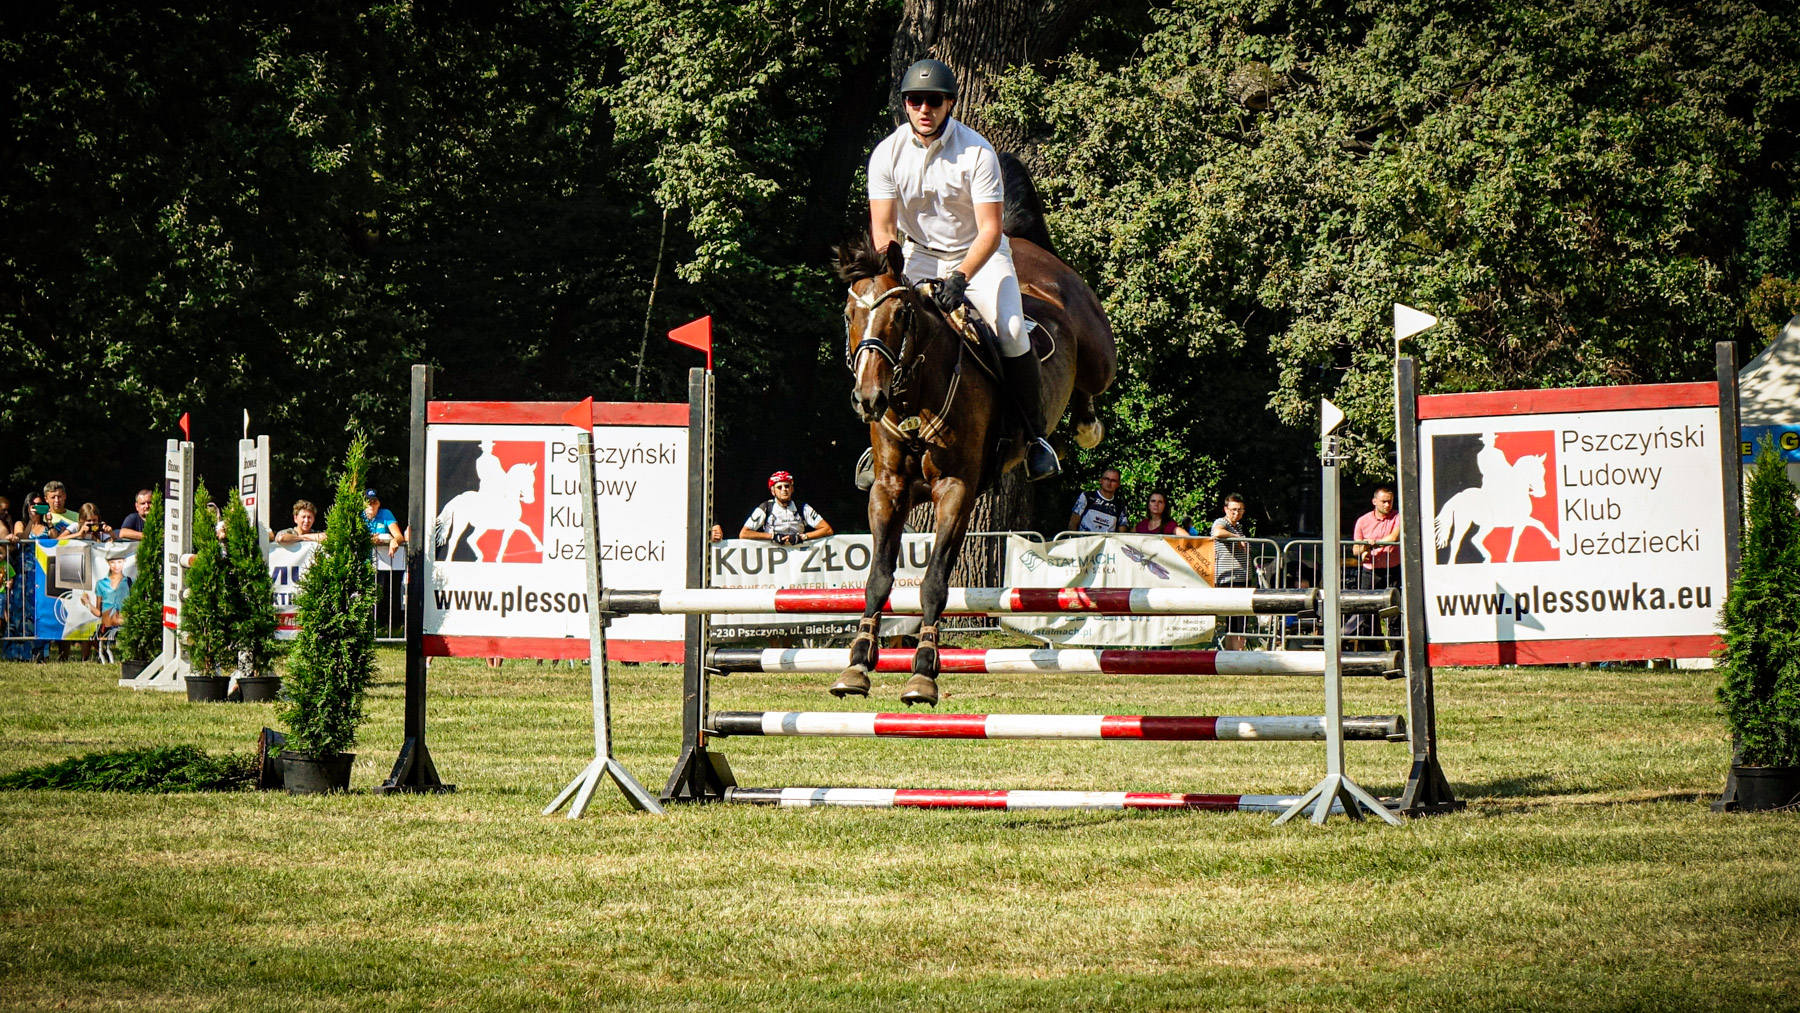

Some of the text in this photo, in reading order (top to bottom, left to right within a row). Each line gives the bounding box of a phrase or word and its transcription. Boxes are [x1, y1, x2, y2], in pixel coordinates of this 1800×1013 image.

[1562, 424, 1704, 456] Pszczyński
[551, 442, 676, 470] Psczyński
[1563, 463, 1663, 490] Ludowy
[550, 506, 584, 528] Klu
[1565, 497, 1622, 521] Klub
[548, 538, 665, 561] Jeźziecki
[1566, 528, 1699, 556] Jeździecki
[434, 585, 589, 618] www.plesso
[1436, 582, 1712, 621] www.plessowka.eu
[738, 626, 788, 637] Pszczyna,
[790, 625, 803, 635] ul.
[805, 624, 843, 635] Bielska
